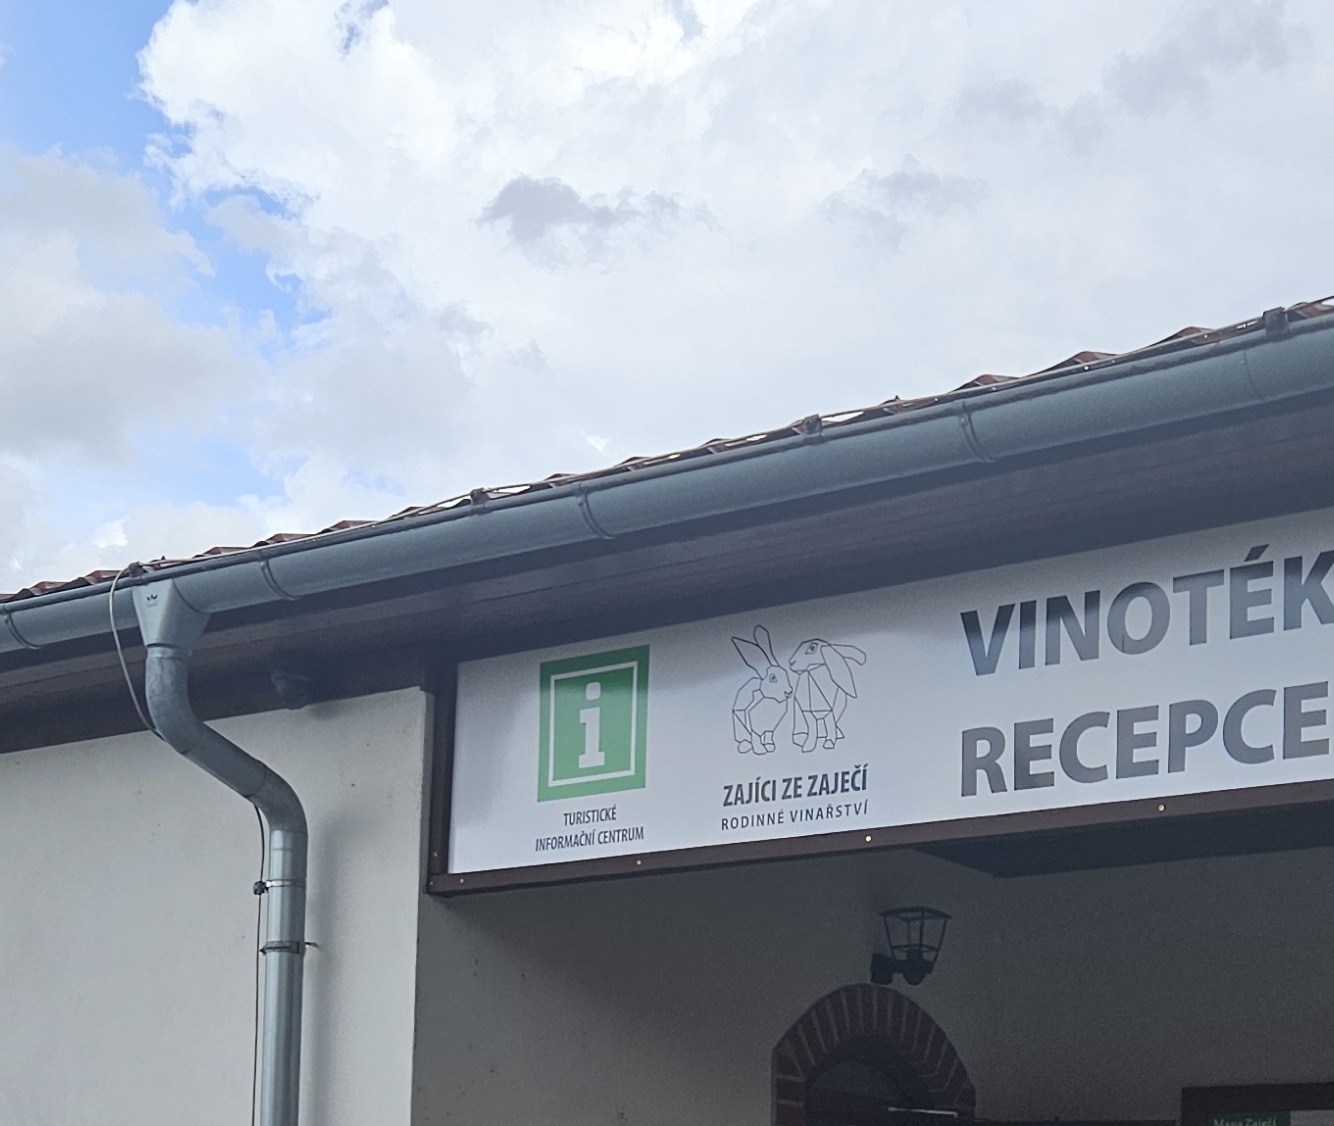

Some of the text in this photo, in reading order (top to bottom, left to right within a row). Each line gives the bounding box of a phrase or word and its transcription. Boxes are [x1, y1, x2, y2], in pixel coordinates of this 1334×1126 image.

[960, 681, 1330, 798] RECEPCE
[722, 763, 869, 808] ZAJÍCI ZE ZAJEČÍ
[562, 804, 617, 827] TURISTICKÉ
[721, 798, 869, 831] RODINNÉ VINAŘSTVÍ
[535, 826, 645, 852] INFORMAČNÍ CENTRUM
